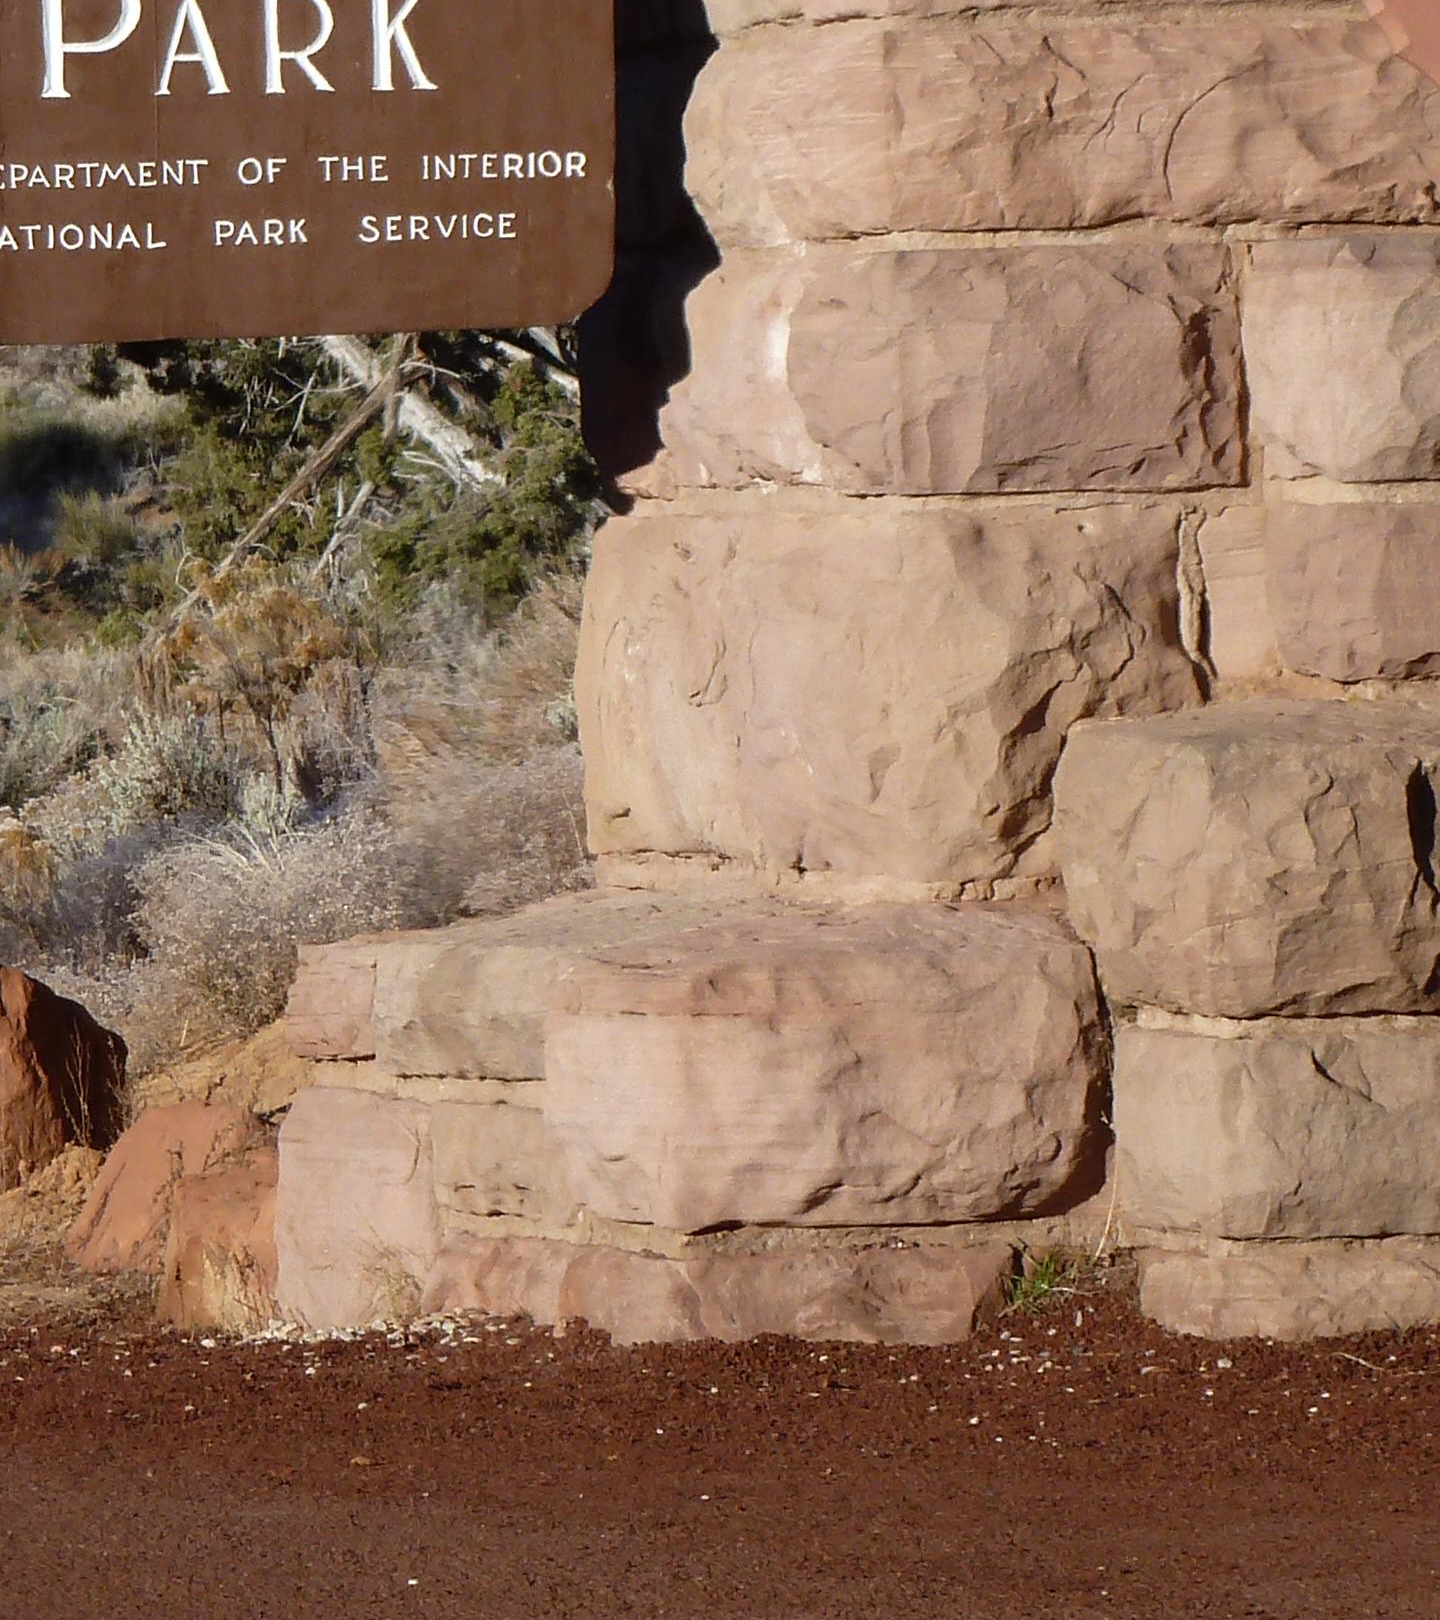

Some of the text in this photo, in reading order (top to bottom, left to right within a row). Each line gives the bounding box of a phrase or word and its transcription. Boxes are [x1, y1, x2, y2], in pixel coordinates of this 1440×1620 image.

[235, 155, 288, 186] OF
[316, 154, 390, 183] THE
[420, 148, 588, 181] INTERIOR
[213, 217, 309, 247] PARK
[356, 211, 519, 244] SERVICE
